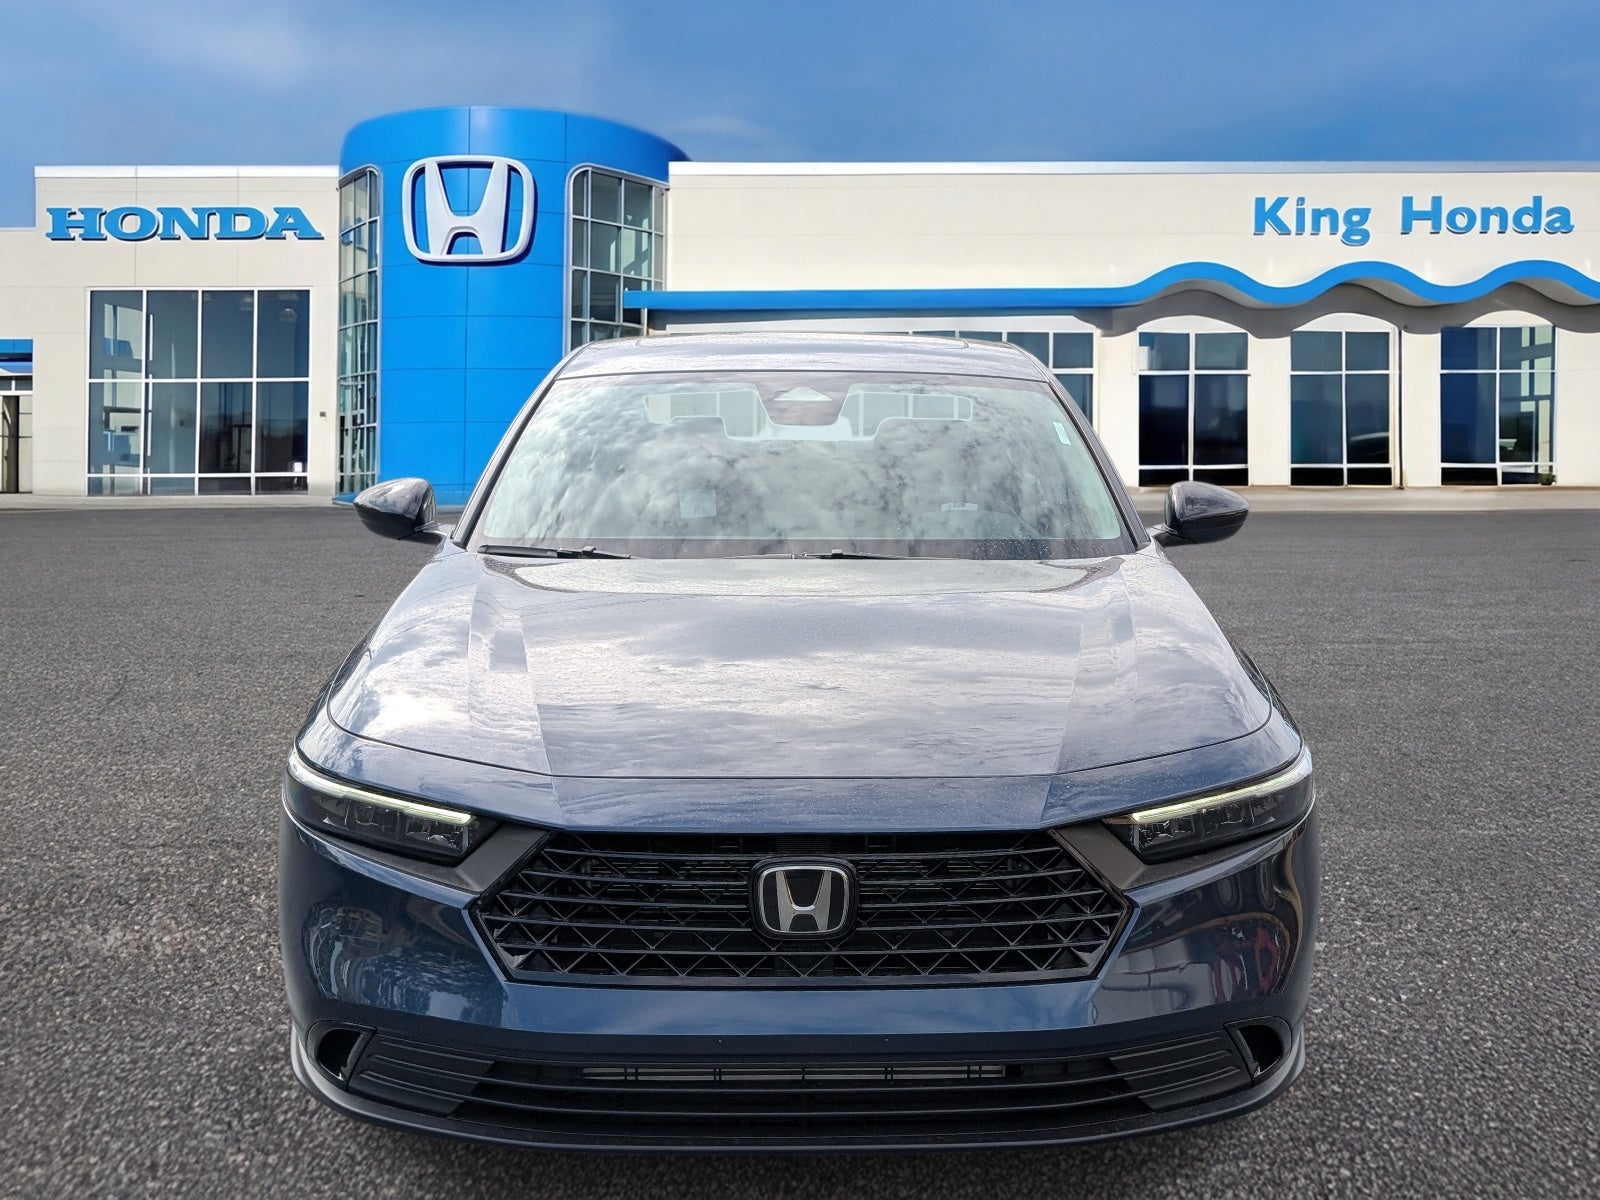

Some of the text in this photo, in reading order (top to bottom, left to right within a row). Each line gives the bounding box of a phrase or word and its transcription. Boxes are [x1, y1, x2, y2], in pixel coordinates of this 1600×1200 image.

[45, 206, 324, 241] HONDA
[1253, 195, 1575, 246] King Honda
